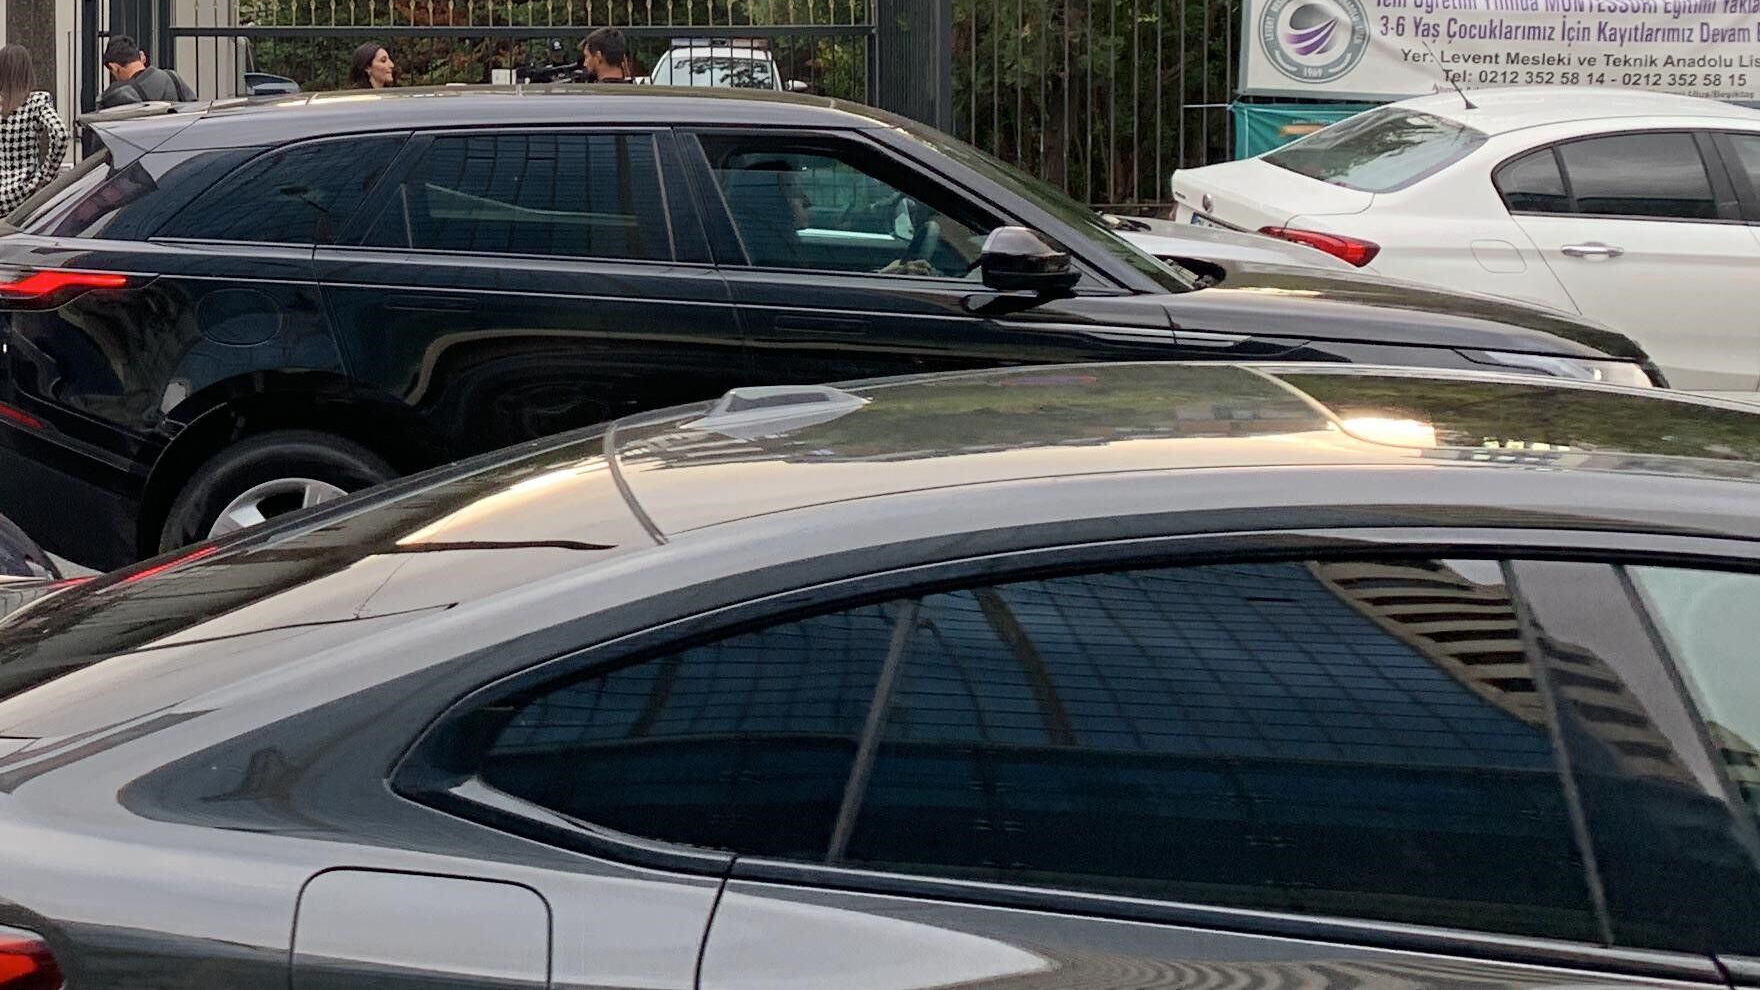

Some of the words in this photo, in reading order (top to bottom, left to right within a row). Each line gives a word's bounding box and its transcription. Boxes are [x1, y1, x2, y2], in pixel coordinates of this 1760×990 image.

[1380, 15, 1405, 37] 3-6
[1413, 16, 1440, 43] Yaş
[1446, 17, 1555, 44] Çocuklarımız
[1561, 15, 1590, 46] İçin
[1597, 21, 1693, 47] Kayıtlarımız
[1700, 22, 1751, 42] Devam
[1401, 48, 1434, 63] Yer:
[1440, 50, 1500, 65] Levent
[1505, 52, 1571, 66] Mesleki
[1577, 56, 1597, 66] ve
[1603, 54, 1659, 67] Teknik
[1663, 55, 1733, 68] Anadolu
[1442, 69, 1472, 82] Tel:
[1478, 70, 1519, 84] 0212
[1525, 71, 1554, 85] 352
[1560, 72, 1579, 85] 58
[1586, 73, 1605, 85] 14
[1622, 73, 1662, 86] 0212
[1667, 73, 1697, 86] 352
[1703, 74, 1722, 86] 58
[1729, 74, 1747, 86] 15
